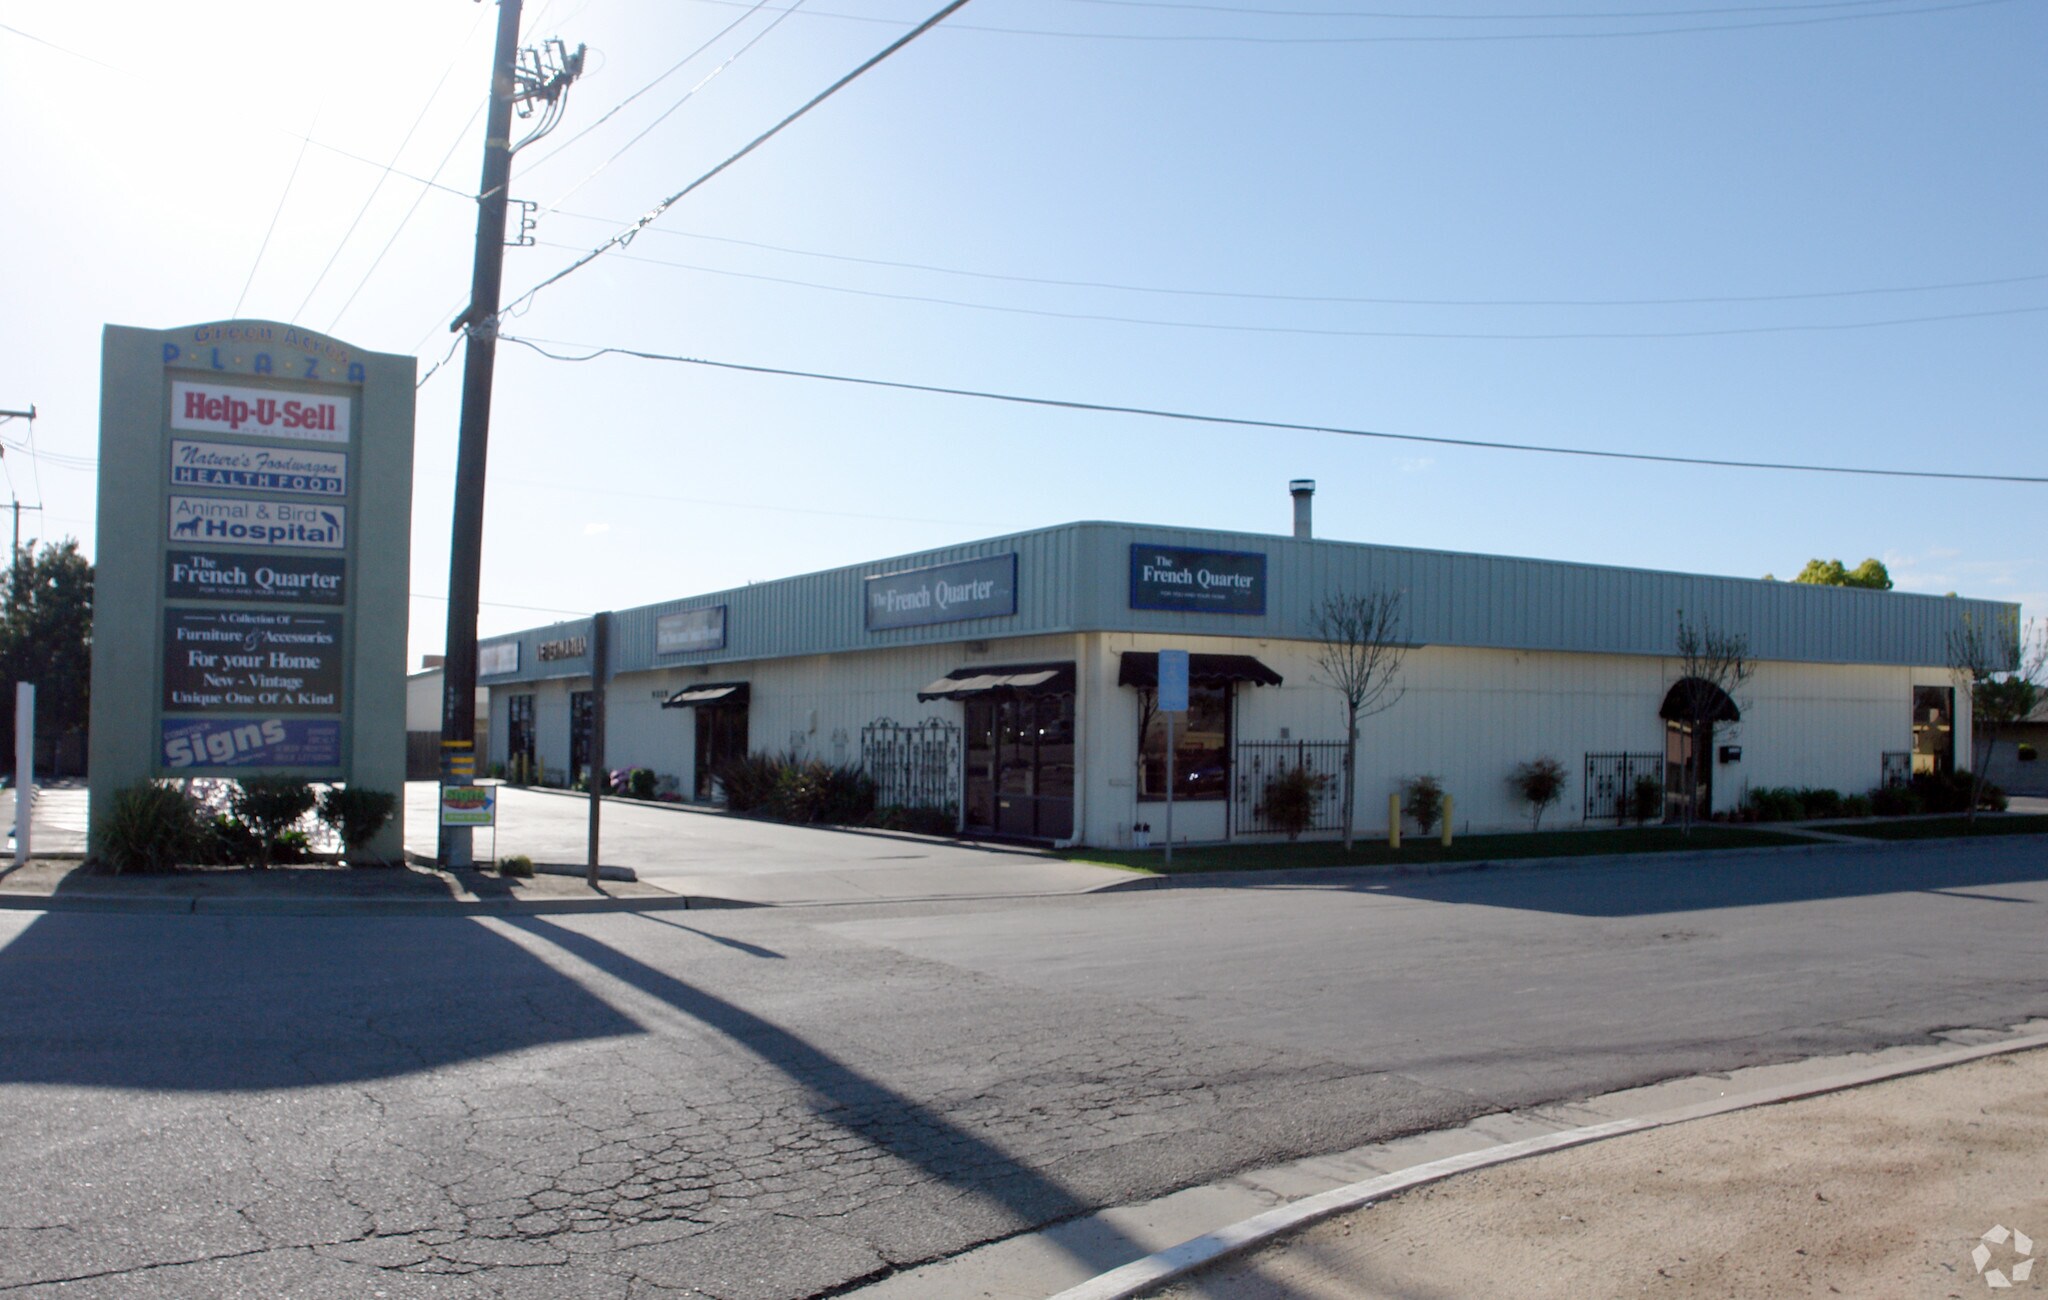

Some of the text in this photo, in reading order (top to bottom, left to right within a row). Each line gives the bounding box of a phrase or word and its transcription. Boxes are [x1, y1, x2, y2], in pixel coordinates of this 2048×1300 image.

[194, 325, 272, 342] Green
[184, 391, 335, 431] Help-U-Sell
[179, 446, 337, 476] Nature's Foodwagon
[181, 469, 338, 491] HEALTH FOOD
[177, 500, 317, 522] Animal & Bird
[206, 520, 334, 543] Hospital
[191, 556, 216, 568] The
[1155, 556, 1173, 567] The
[172, 564, 341, 590] French Quarter
[1143, 565, 1254, 588] French Quarter
[886, 584, 931, 613] French
[935, 579, 994, 609] Quarter
[218, 614, 291, 625] A Collection Of
[177, 628, 243, 641] Furniture
[263, 631, 333, 643] Accessories
[188, 650, 321, 671] For your Home
[203, 674, 235, 687] New
[249, 674, 303, 690] Vintage
[172, 691, 334, 706] Unique One Of A Kind
